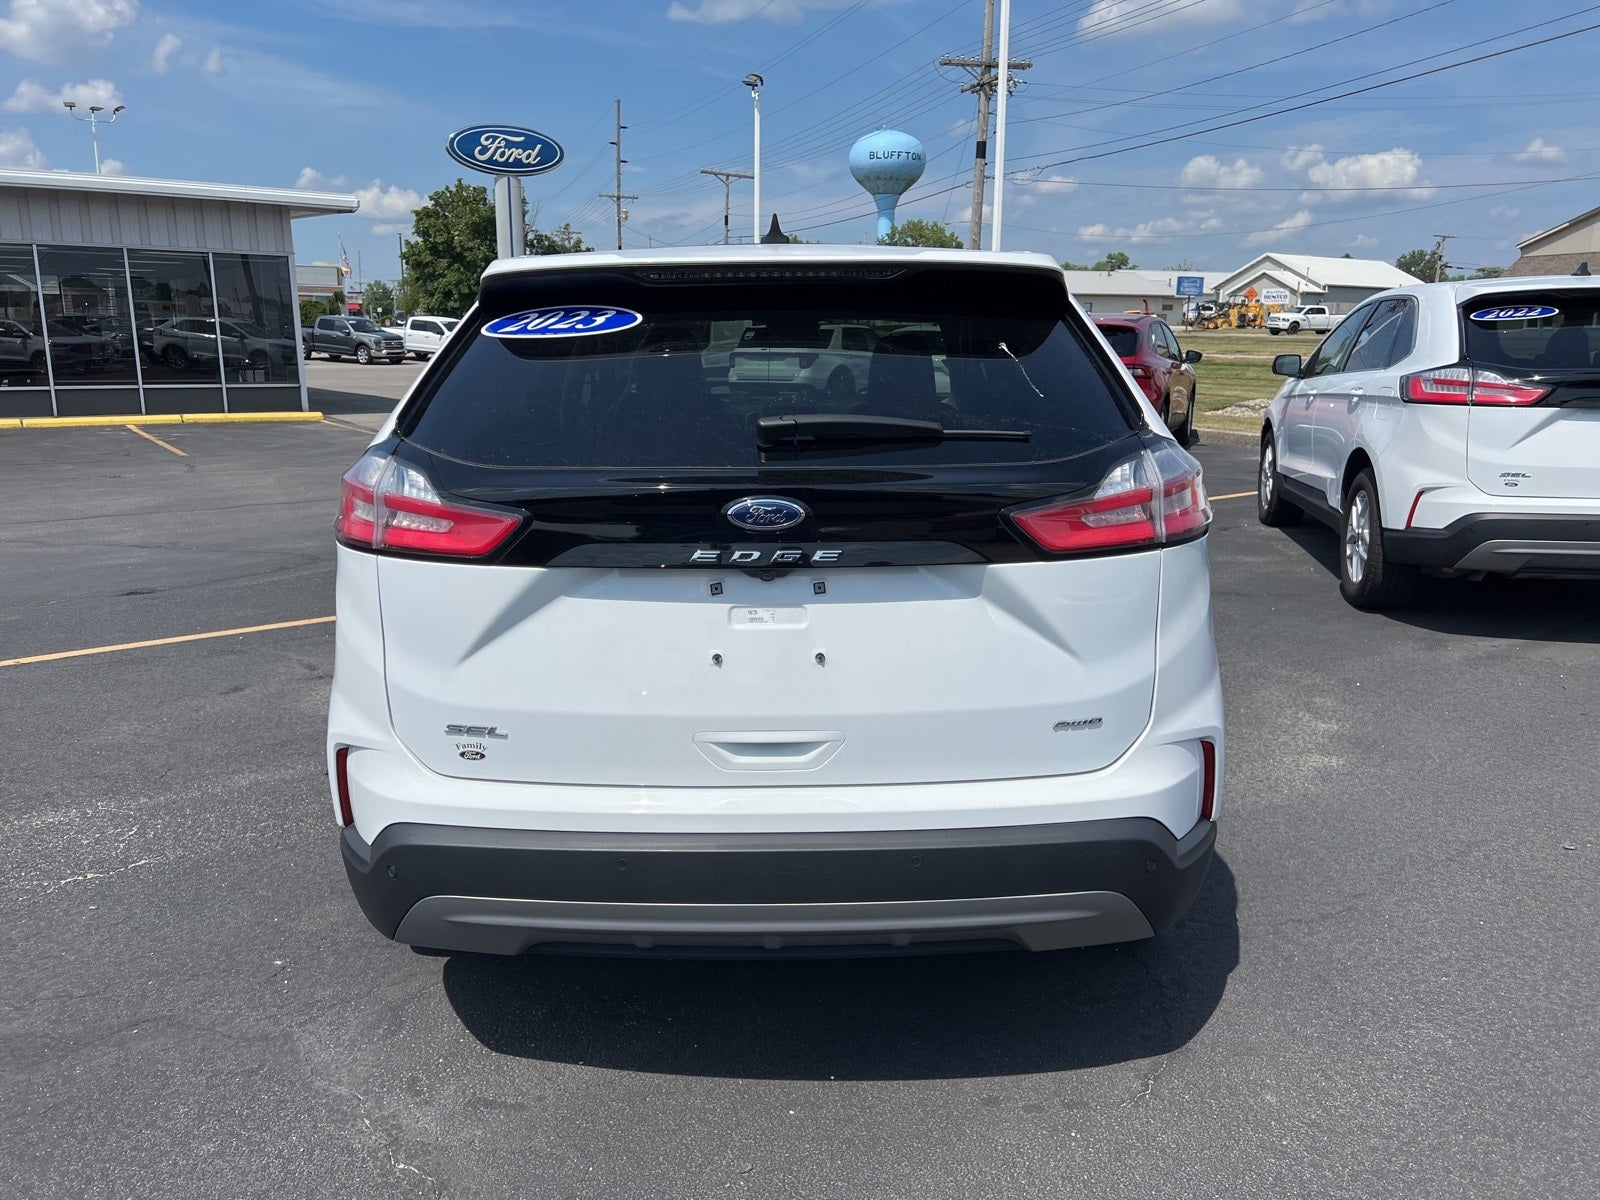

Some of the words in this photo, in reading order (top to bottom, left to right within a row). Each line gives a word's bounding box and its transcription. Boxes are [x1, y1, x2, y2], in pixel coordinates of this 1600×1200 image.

[474, 132, 542, 165] Ford
[869, 150, 922, 161] BLUFFTON
[1486, 307, 1543, 319] 2022
[497, 310, 617, 333] 2023
[746, 505, 787, 524] Ford
[689, 550, 842, 563] EDGE
[1053, 717, 1103, 732] AWD
[444, 724, 508, 740] SEL
[455, 742, 488, 752] Family
[463, 751, 481, 759] Ford
